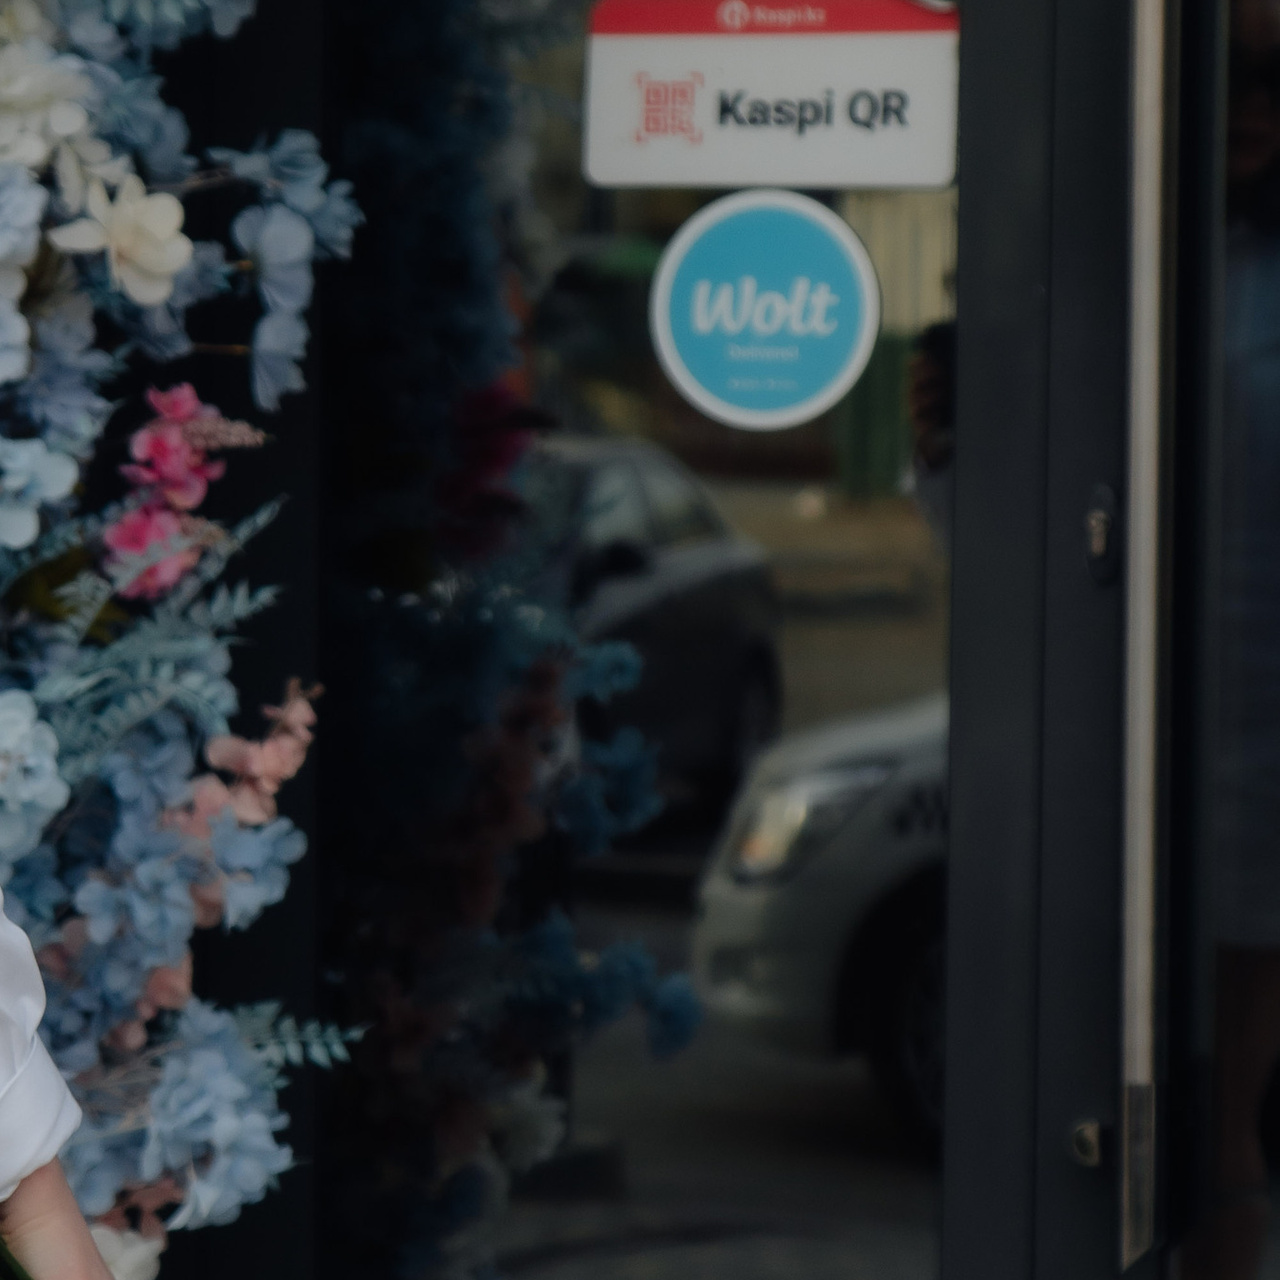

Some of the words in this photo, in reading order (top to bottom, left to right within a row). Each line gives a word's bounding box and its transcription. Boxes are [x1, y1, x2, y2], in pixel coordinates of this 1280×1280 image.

[717, 89, 834, 135] Kaspi
[849, 89, 910, 130] QR
[691, 275, 841, 336] Wolt
